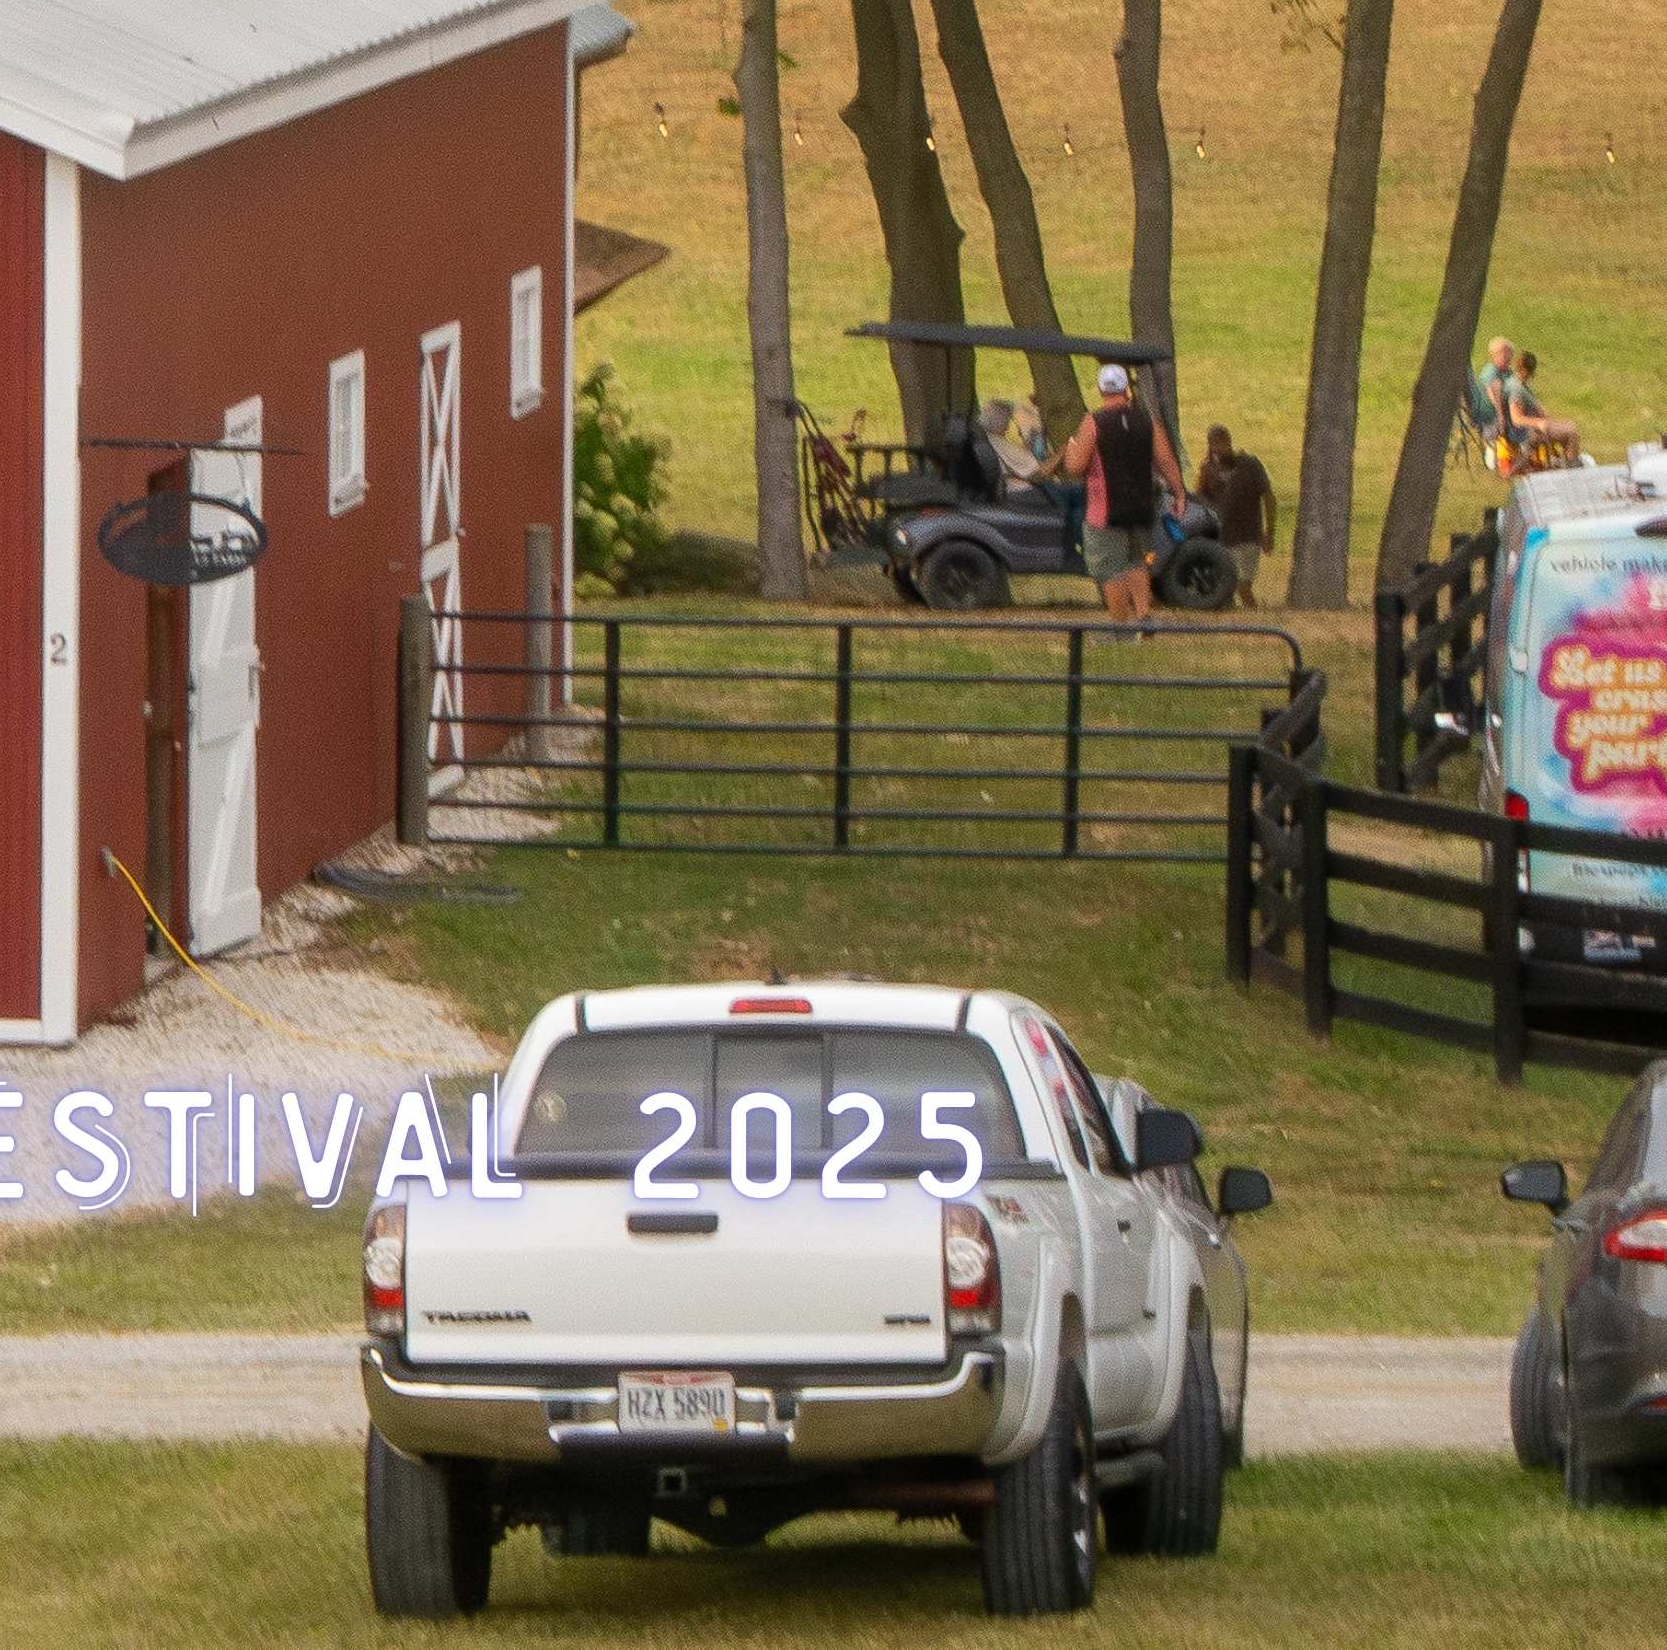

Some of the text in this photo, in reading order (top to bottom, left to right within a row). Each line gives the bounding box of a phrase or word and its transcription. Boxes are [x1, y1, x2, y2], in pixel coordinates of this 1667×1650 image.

[50, 633, 67, 664] 2
[1623, 660, 1661, 684] us
[1568, 714, 1649, 747] your
[627, 1387, 726, 1420] HZX 5890
